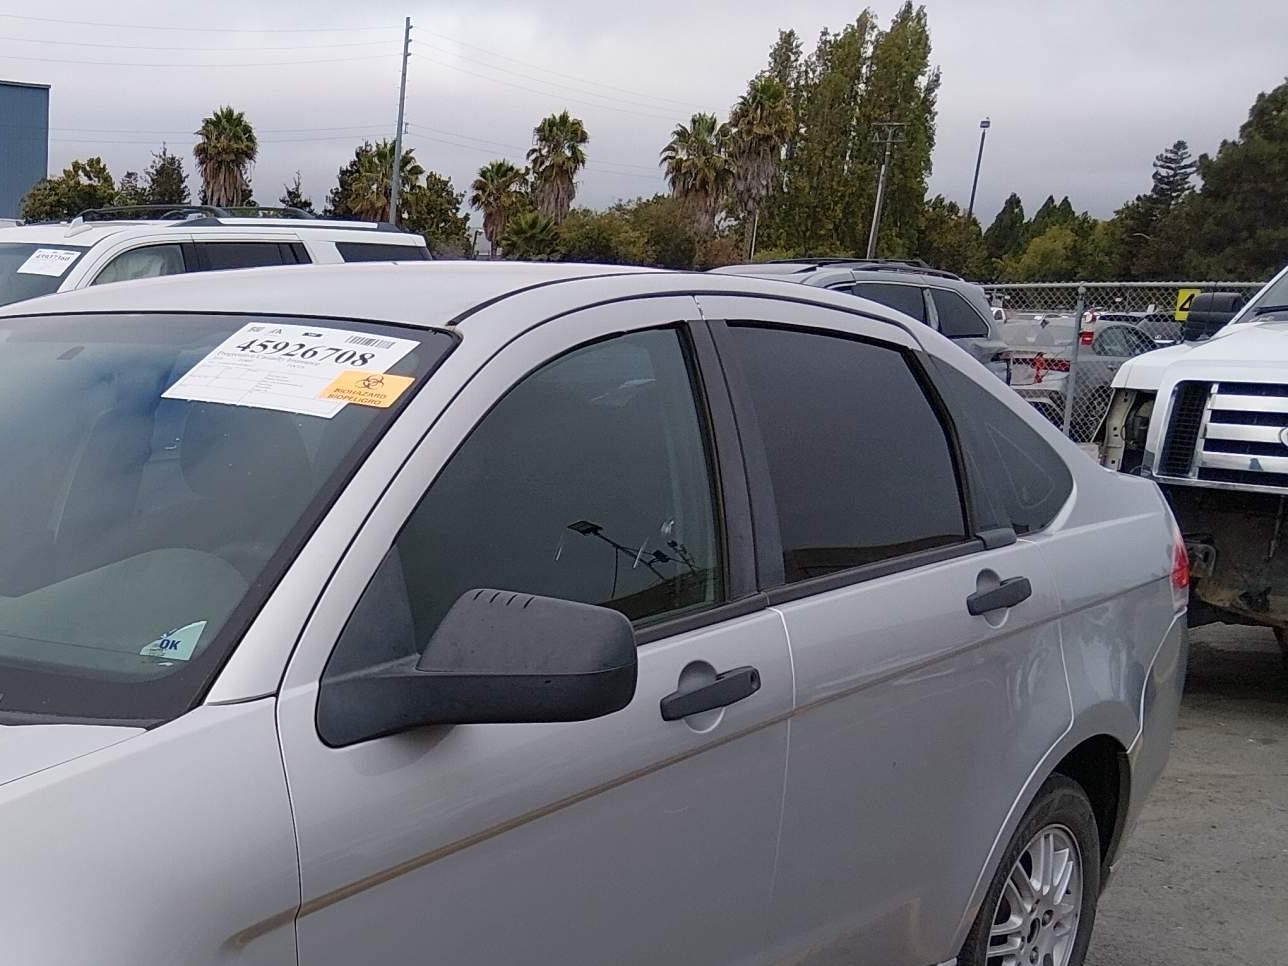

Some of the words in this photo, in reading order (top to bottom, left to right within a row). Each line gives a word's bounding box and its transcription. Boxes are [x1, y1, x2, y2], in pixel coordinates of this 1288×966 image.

[235, 339, 376, 367] 45926708
[327, 393, 383, 406] BIOPELIGRO
[333, 387, 388, 400] BIOHAZARD
[159, 638, 182, 651] OK
